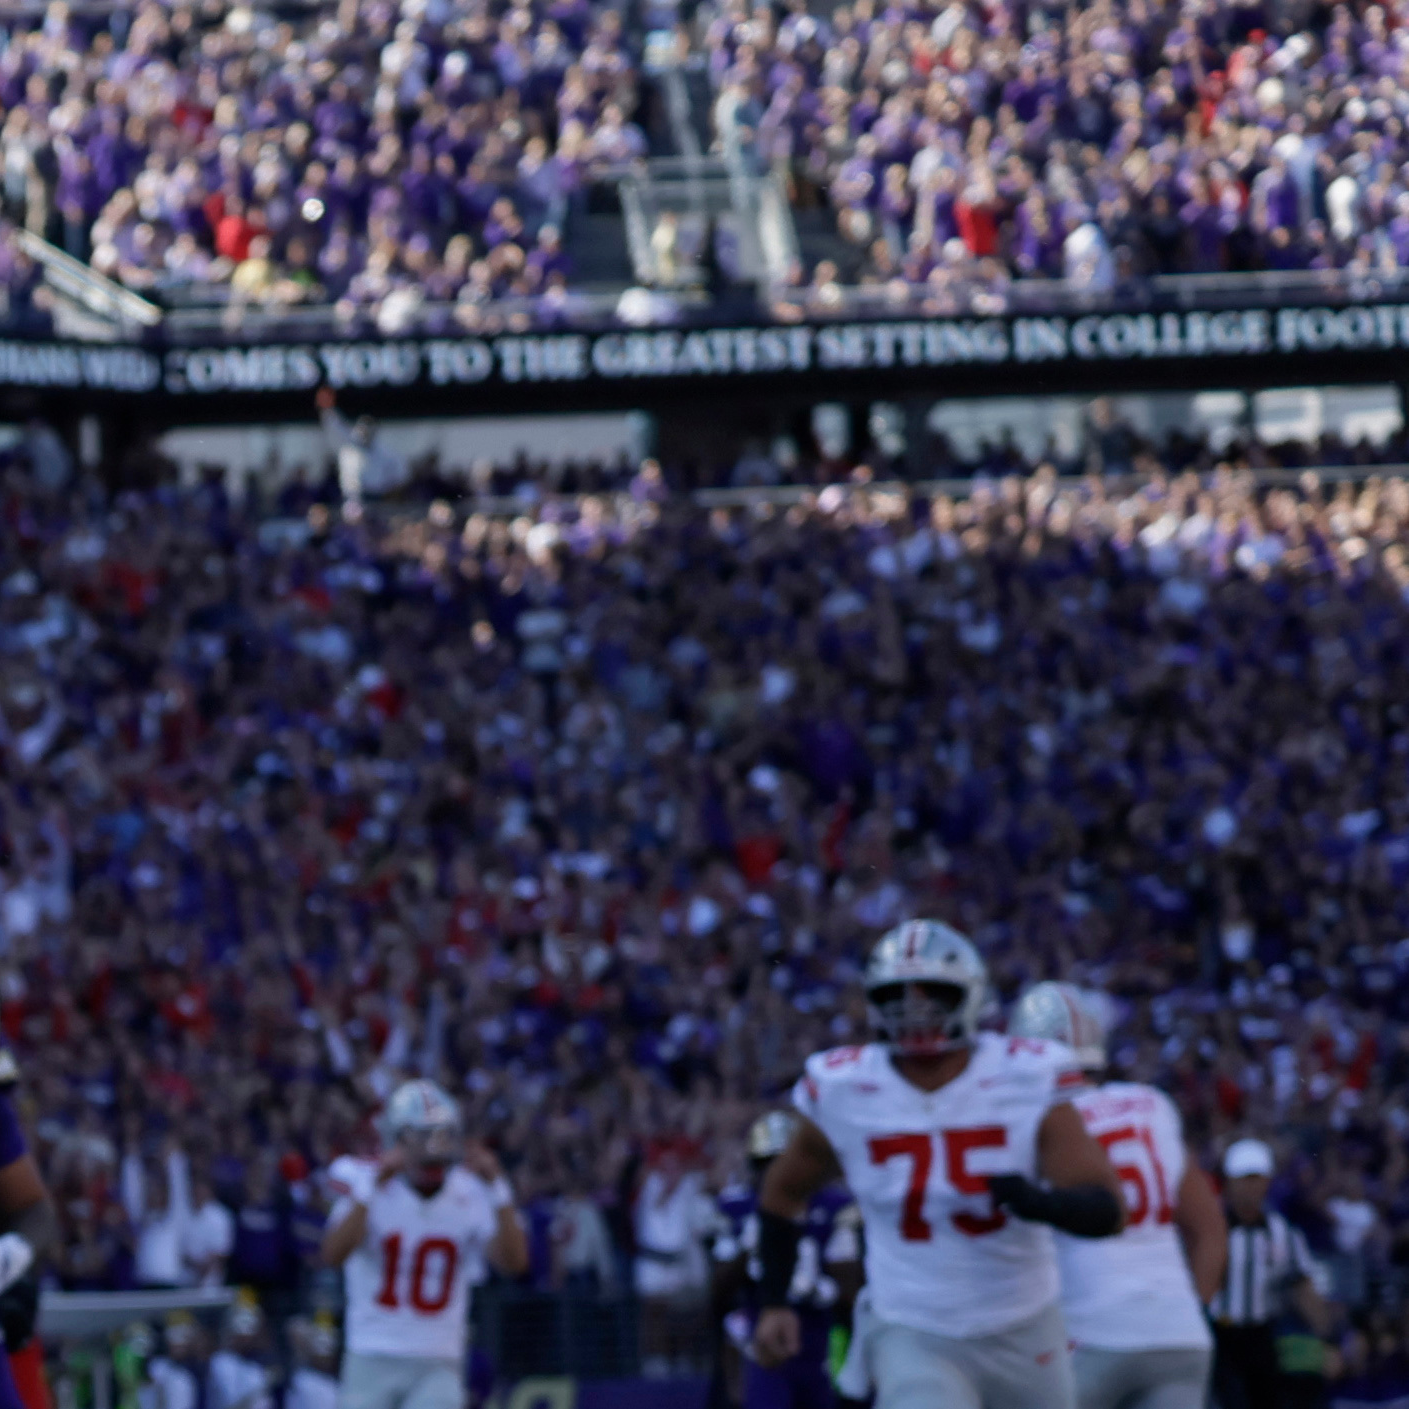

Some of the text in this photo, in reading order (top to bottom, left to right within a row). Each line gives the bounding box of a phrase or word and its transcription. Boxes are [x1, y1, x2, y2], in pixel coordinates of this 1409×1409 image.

[319, 340, 423, 392] YOU
[425, 338, 495, 387] TO
[494, 333, 592, 385] THE
[592, 325, 813, 379] GREATEST
[815, 318, 1010, 372] SETTING
[1012, 316, 1068, 364] IN
[1070, 309, 1272, 363] COLLEGE
[868, 1126, 1007, 1241] 75
[376, 1232, 458, 1315] 10
